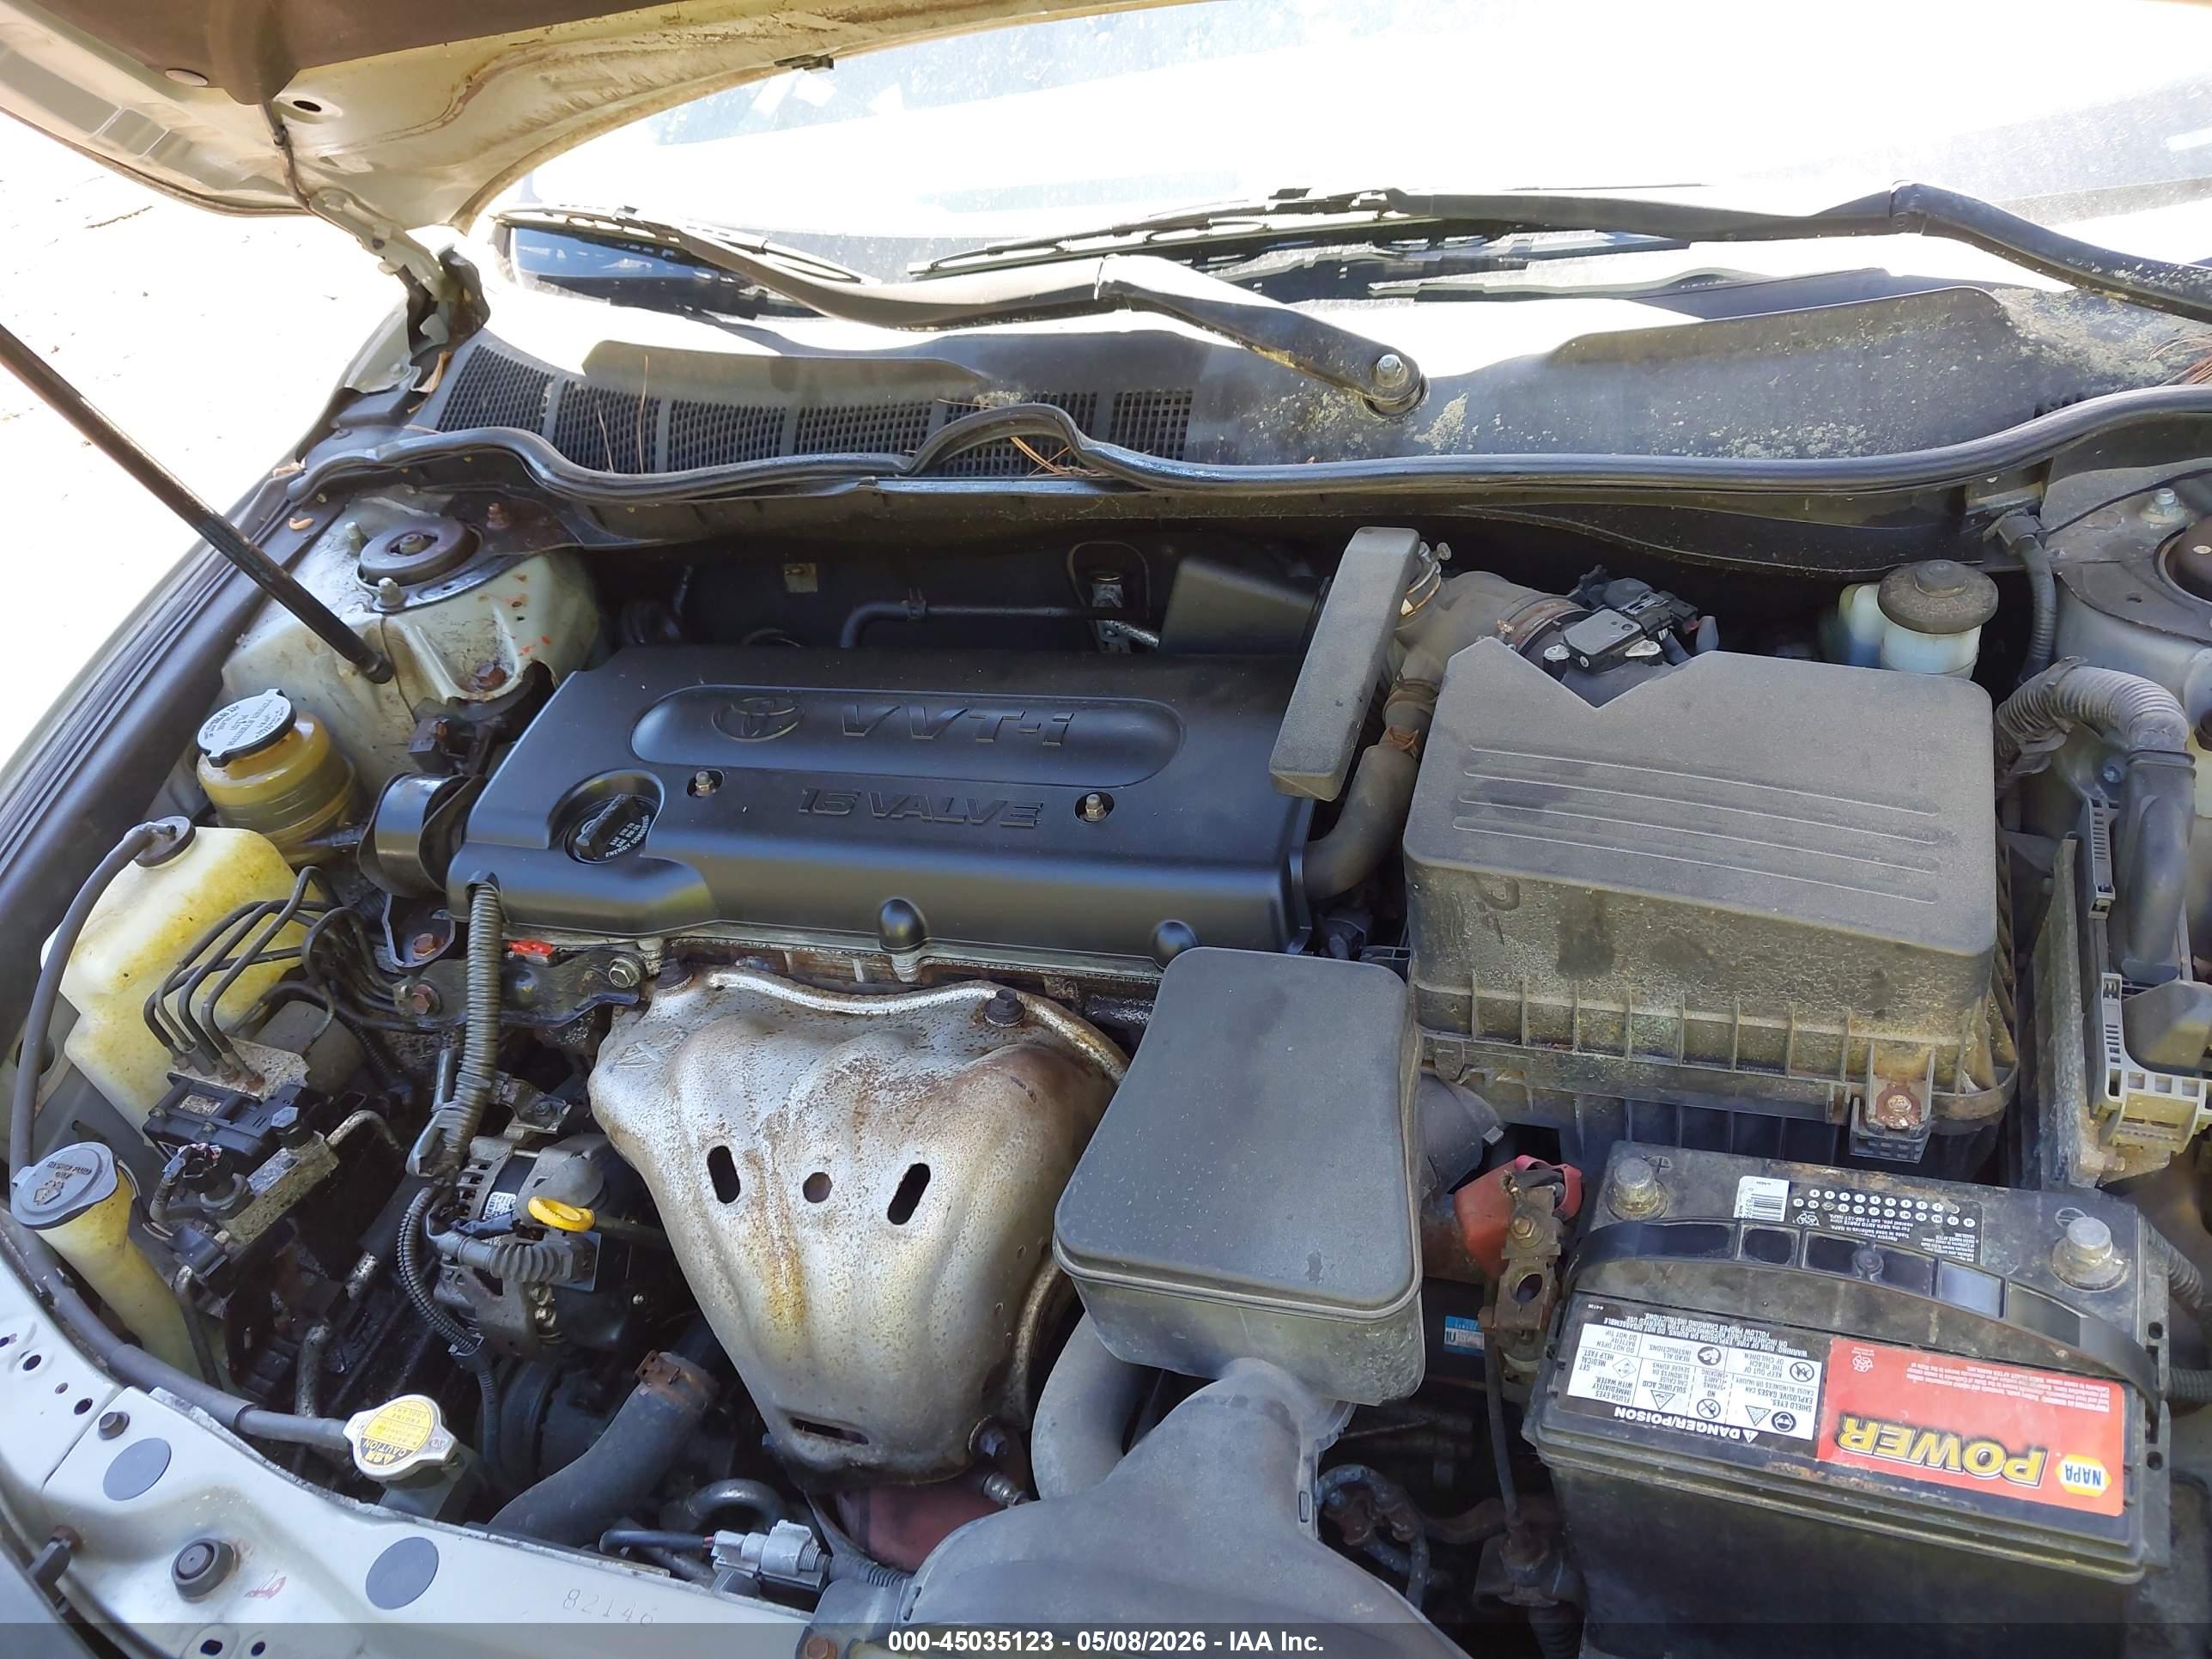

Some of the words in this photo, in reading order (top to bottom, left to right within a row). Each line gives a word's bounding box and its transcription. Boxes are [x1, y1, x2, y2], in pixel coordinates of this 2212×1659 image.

[842, 702, 1074, 746] VVT-i
[799, 788, 861, 816] 16
[867, 791, 1044, 827] VALVE
[605, 843, 631, 857] ENERGY
[1581, 1356, 1606, 1366] MEDICAL
[1599, 1352, 1613, 1360] HELP
[1748, 1359, 1770, 1369] REACH
[1766, 1370, 1782, 1378] KEEP
[1659, 1376, 1676, 1384] CAUSE
[1591, 1382, 1632, 1395] IMMEDIATELY
[1657, 1382, 1686, 1393] SULFURIC
[1756, 1388, 1777, 1397] GASES
[1765, 1382, 1795, 1392] BLINDNESS
[1796, 1387, 1814, 1395] CAUSE
[1595, 1390, 1610, 1399] EYES
[1611, 1393, 1630, 1402] FLUSH
[1778, 1391, 1813, 1403] EXPLOSIVE
[1789, 1401, 1812, 1412] SHIELD
[1613, 1406, 1740, 1437] DANGER/POISON
[362, 1438, 406, 1457] CAUTION
[1836, 1415, 2047, 1486] POWER
[2062, 1463, 2103, 1486] NAPA
